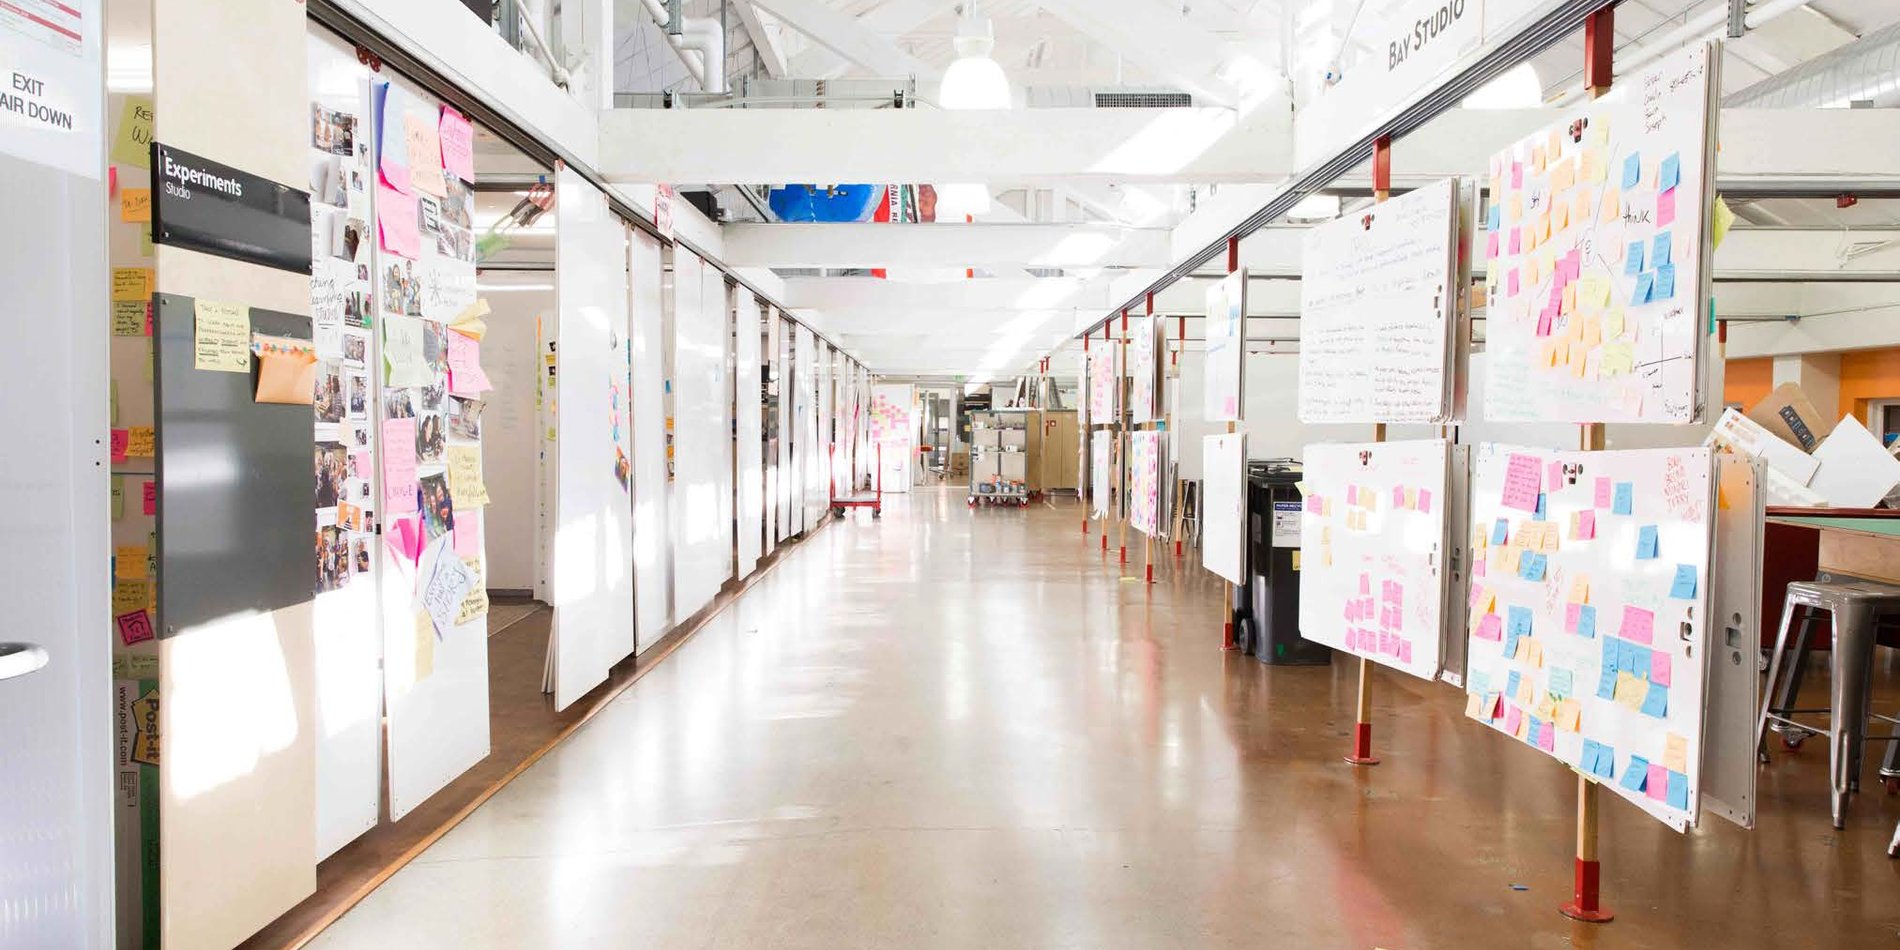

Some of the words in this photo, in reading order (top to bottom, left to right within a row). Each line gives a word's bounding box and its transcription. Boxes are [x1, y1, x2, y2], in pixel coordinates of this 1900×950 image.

[1388, 33, 1411, 72] BAY
[1414, 0, 1465, 51] STUDIO
[12, 72, 45, 97] EXIT
[0, 91, 24, 115] AIR
[28, 101, 73, 130] DOWN
[165, 156, 243, 196] Experiments
[165, 181, 191, 200] Studio
[118, 686, 129, 767] www.post-it.com
[145, 698, 160, 760] Post-it
